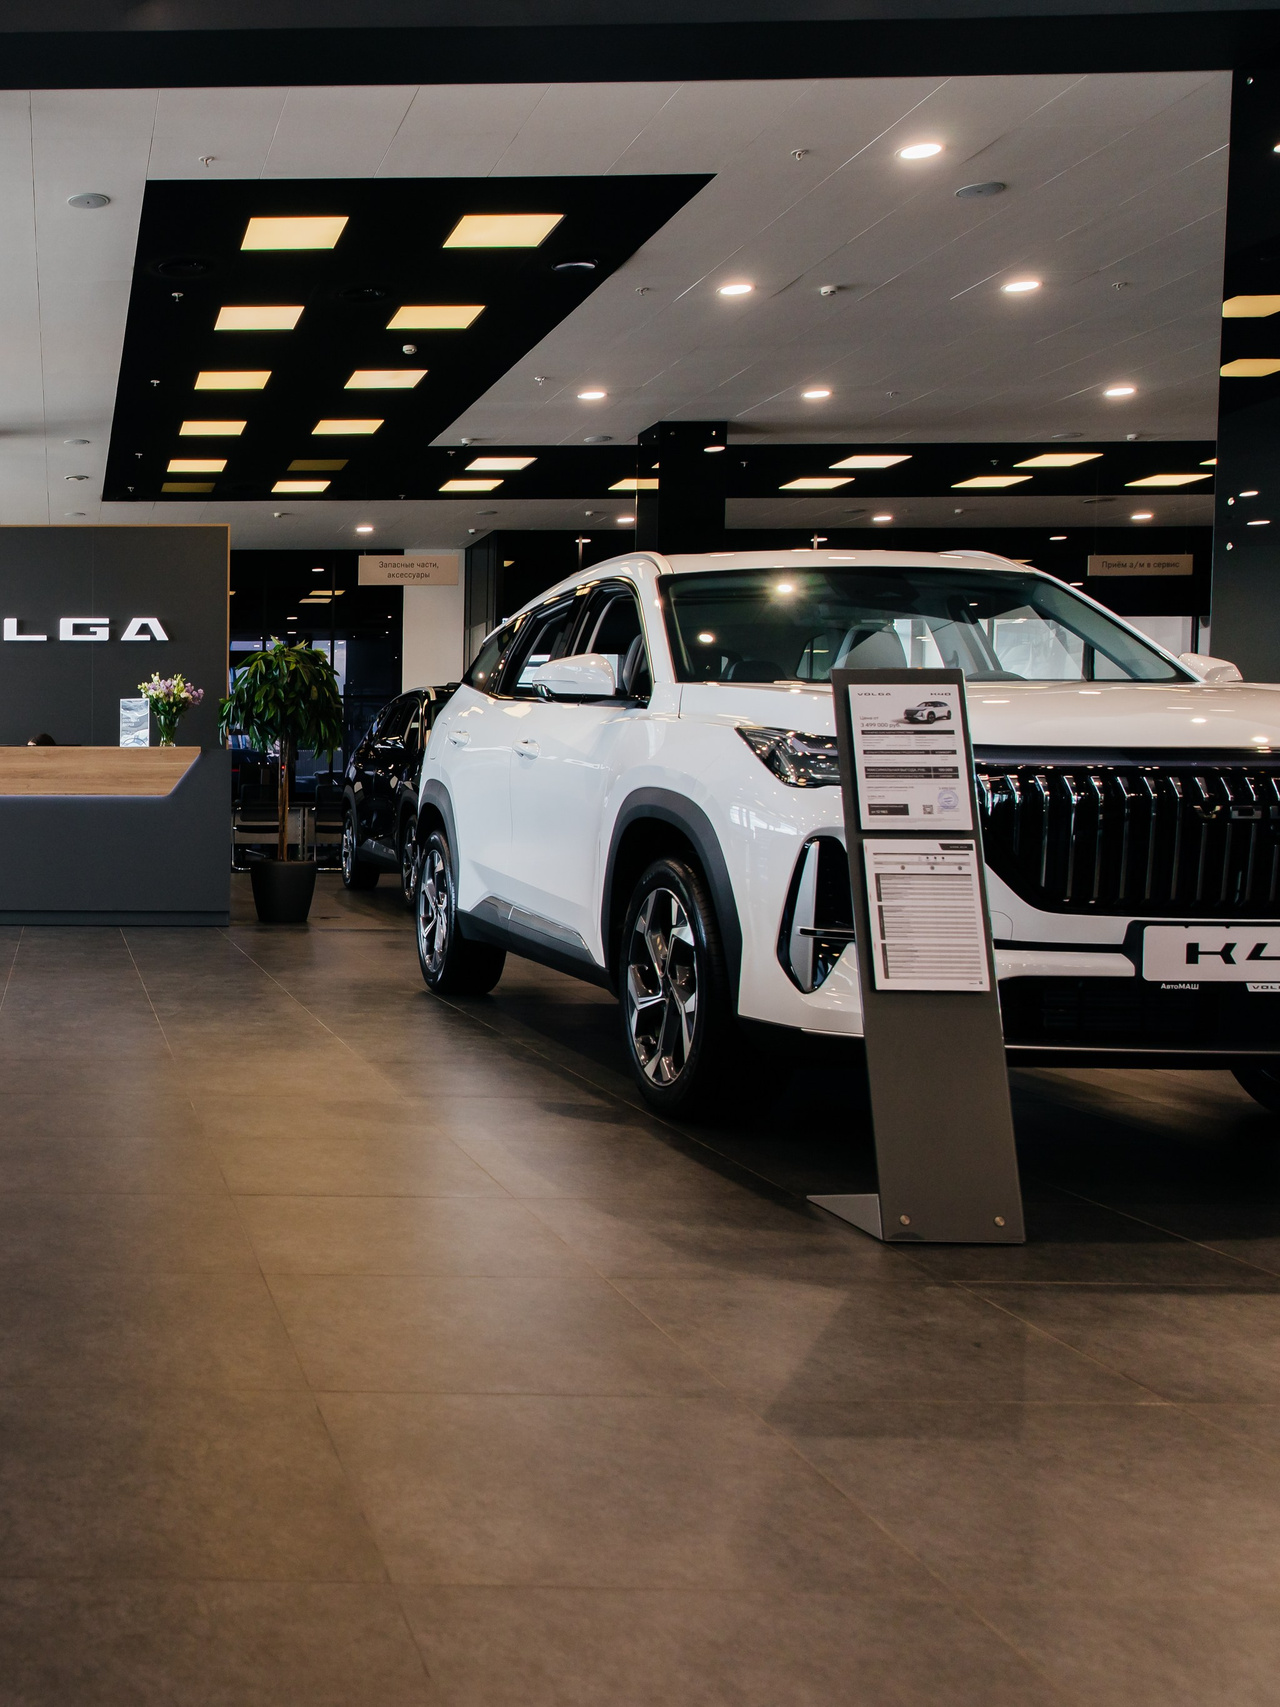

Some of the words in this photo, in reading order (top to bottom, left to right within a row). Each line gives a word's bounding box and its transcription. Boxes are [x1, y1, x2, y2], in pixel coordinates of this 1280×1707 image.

[378, 560, 415, 569] Запасные
[416, 561, 439, 569] части,
[1101, 560, 1127, 570] Приём
[1128, 561, 1145, 569] а/м
[1185, 942, 1280, 965] K4
